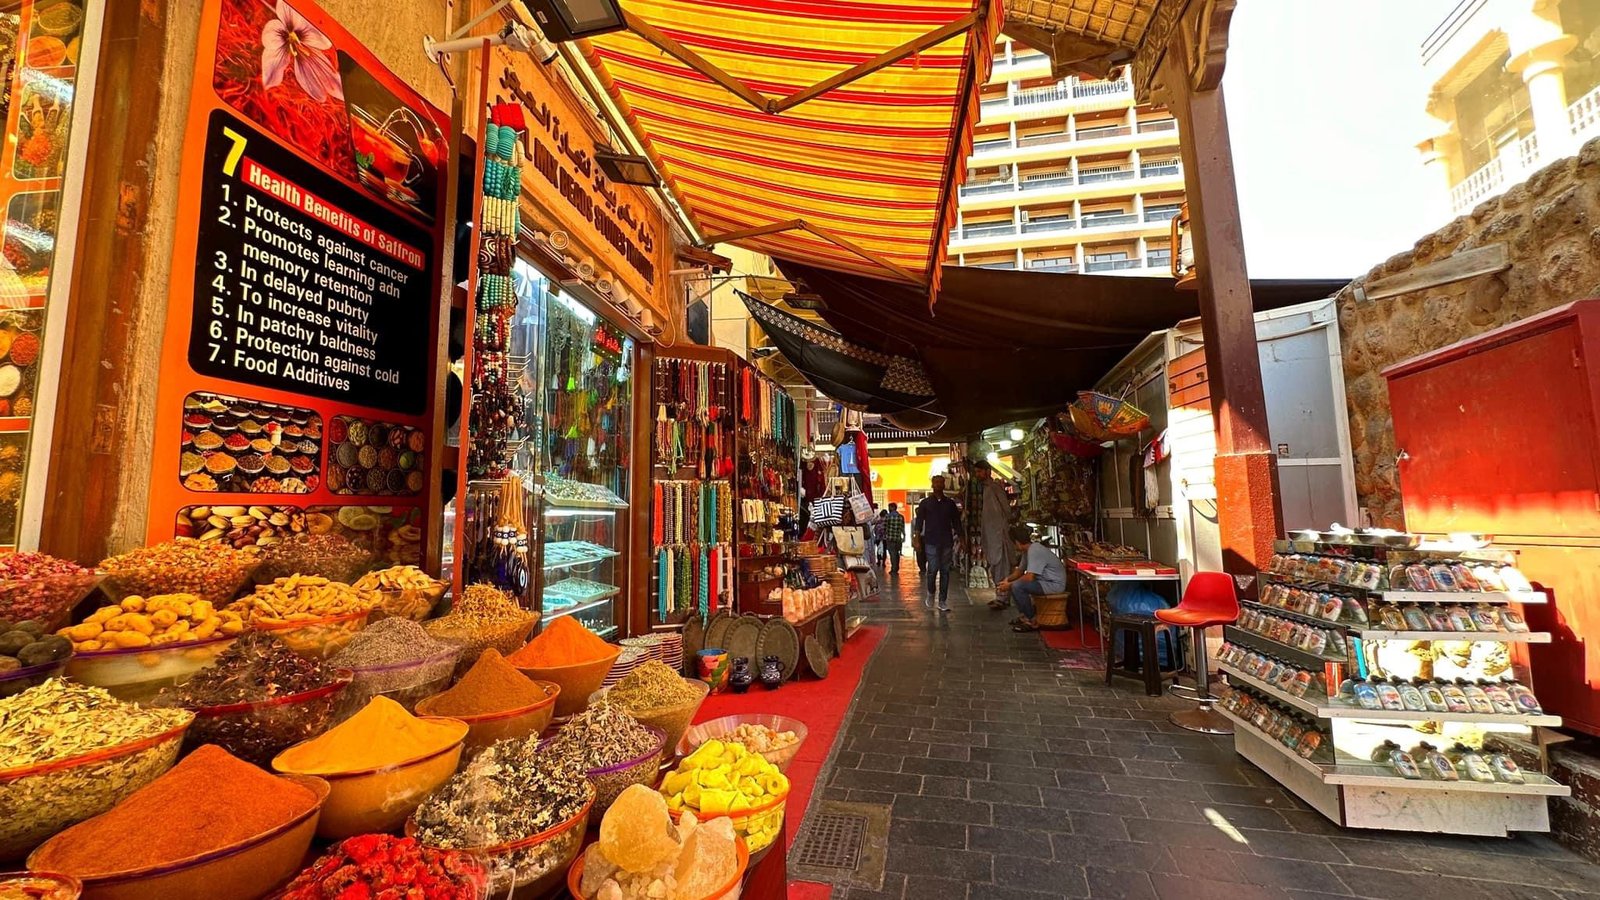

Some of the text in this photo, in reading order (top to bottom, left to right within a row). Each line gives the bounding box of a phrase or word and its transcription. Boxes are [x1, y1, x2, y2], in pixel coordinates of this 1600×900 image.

[223, 126, 422, 268] 7 Health Benefits of Saffron
[534, 137, 559, 189] MIX
[559, 166, 593, 223] BEADS
[218, 205, 400, 299] 2. Promotes learning adn
[221, 184, 409, 284] 1. Protects against cancer
[212, 274, 378, 346] 4. To increase vitality
[214, 250, 369, 324] 3. In delayed pubrty
[243, 243, 373, 306] memory retention
[209, 320, 399, 384] 6. Protection against cold
[211, 296, 376, 360] 5. In patchy baldness
[208, 342, 350, 391] 7. Food Additives
